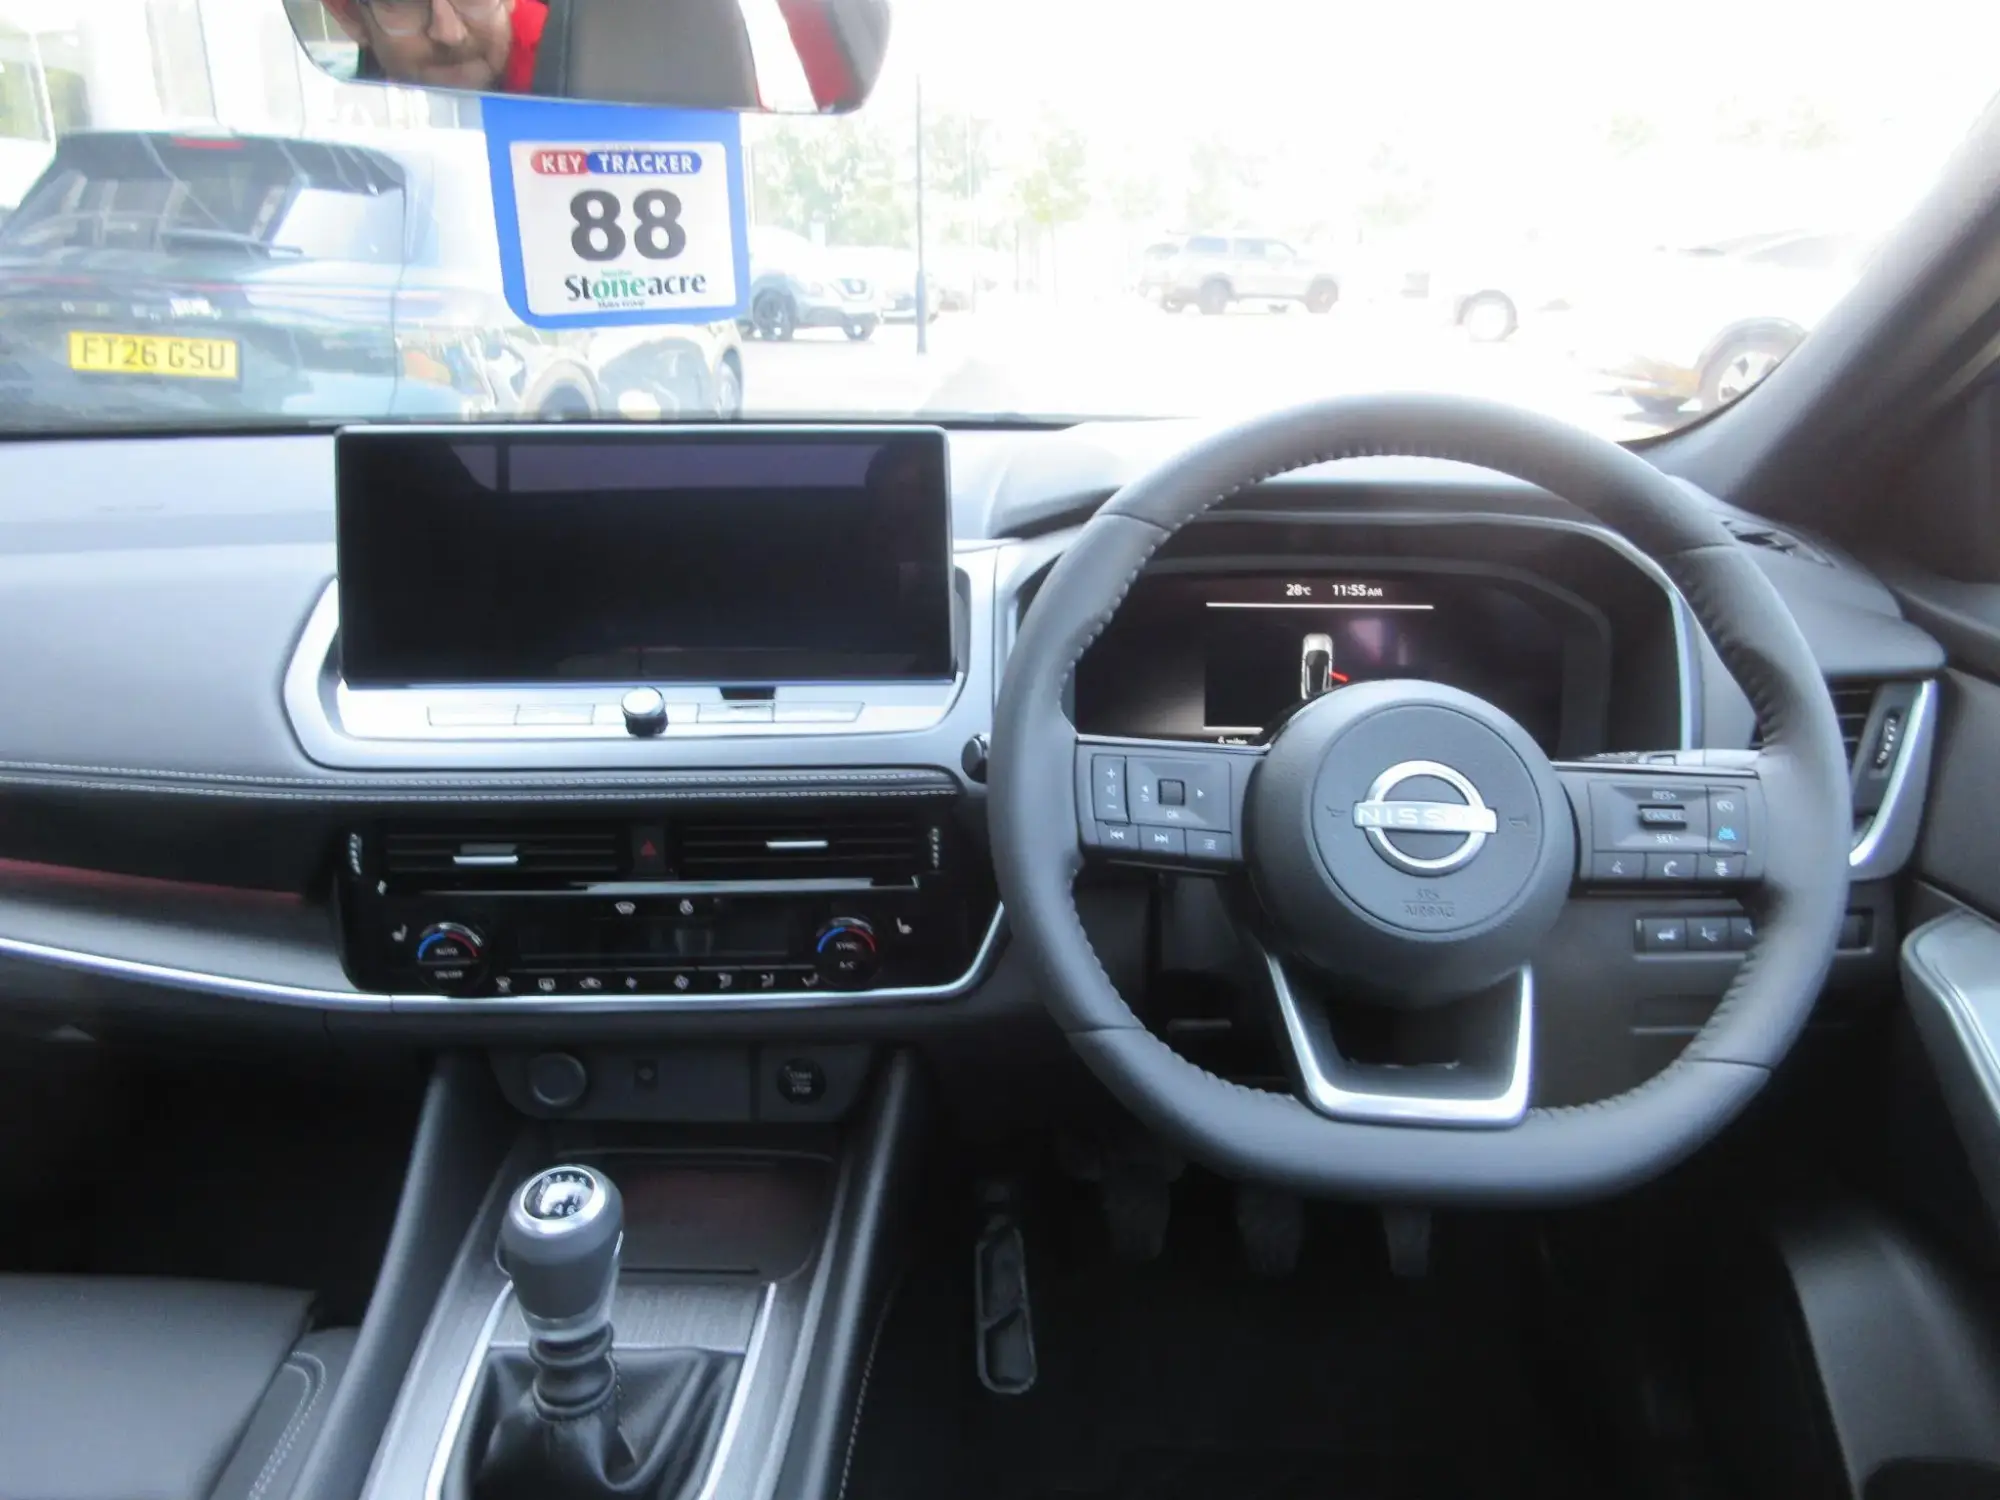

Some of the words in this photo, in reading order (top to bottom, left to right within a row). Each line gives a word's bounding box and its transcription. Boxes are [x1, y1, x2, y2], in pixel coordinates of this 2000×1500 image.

[540, 152, 583, 173] KEY
[597, 153, 693, 173] TRACKER
[570, 189, 687, 262] 88
[564, 273, 707, 302] Stoneacre
[82, 336, 158, 367] FT26
[168, 341, 225, 371] GSU
[1332, 583, 1367, 597] 11:55
